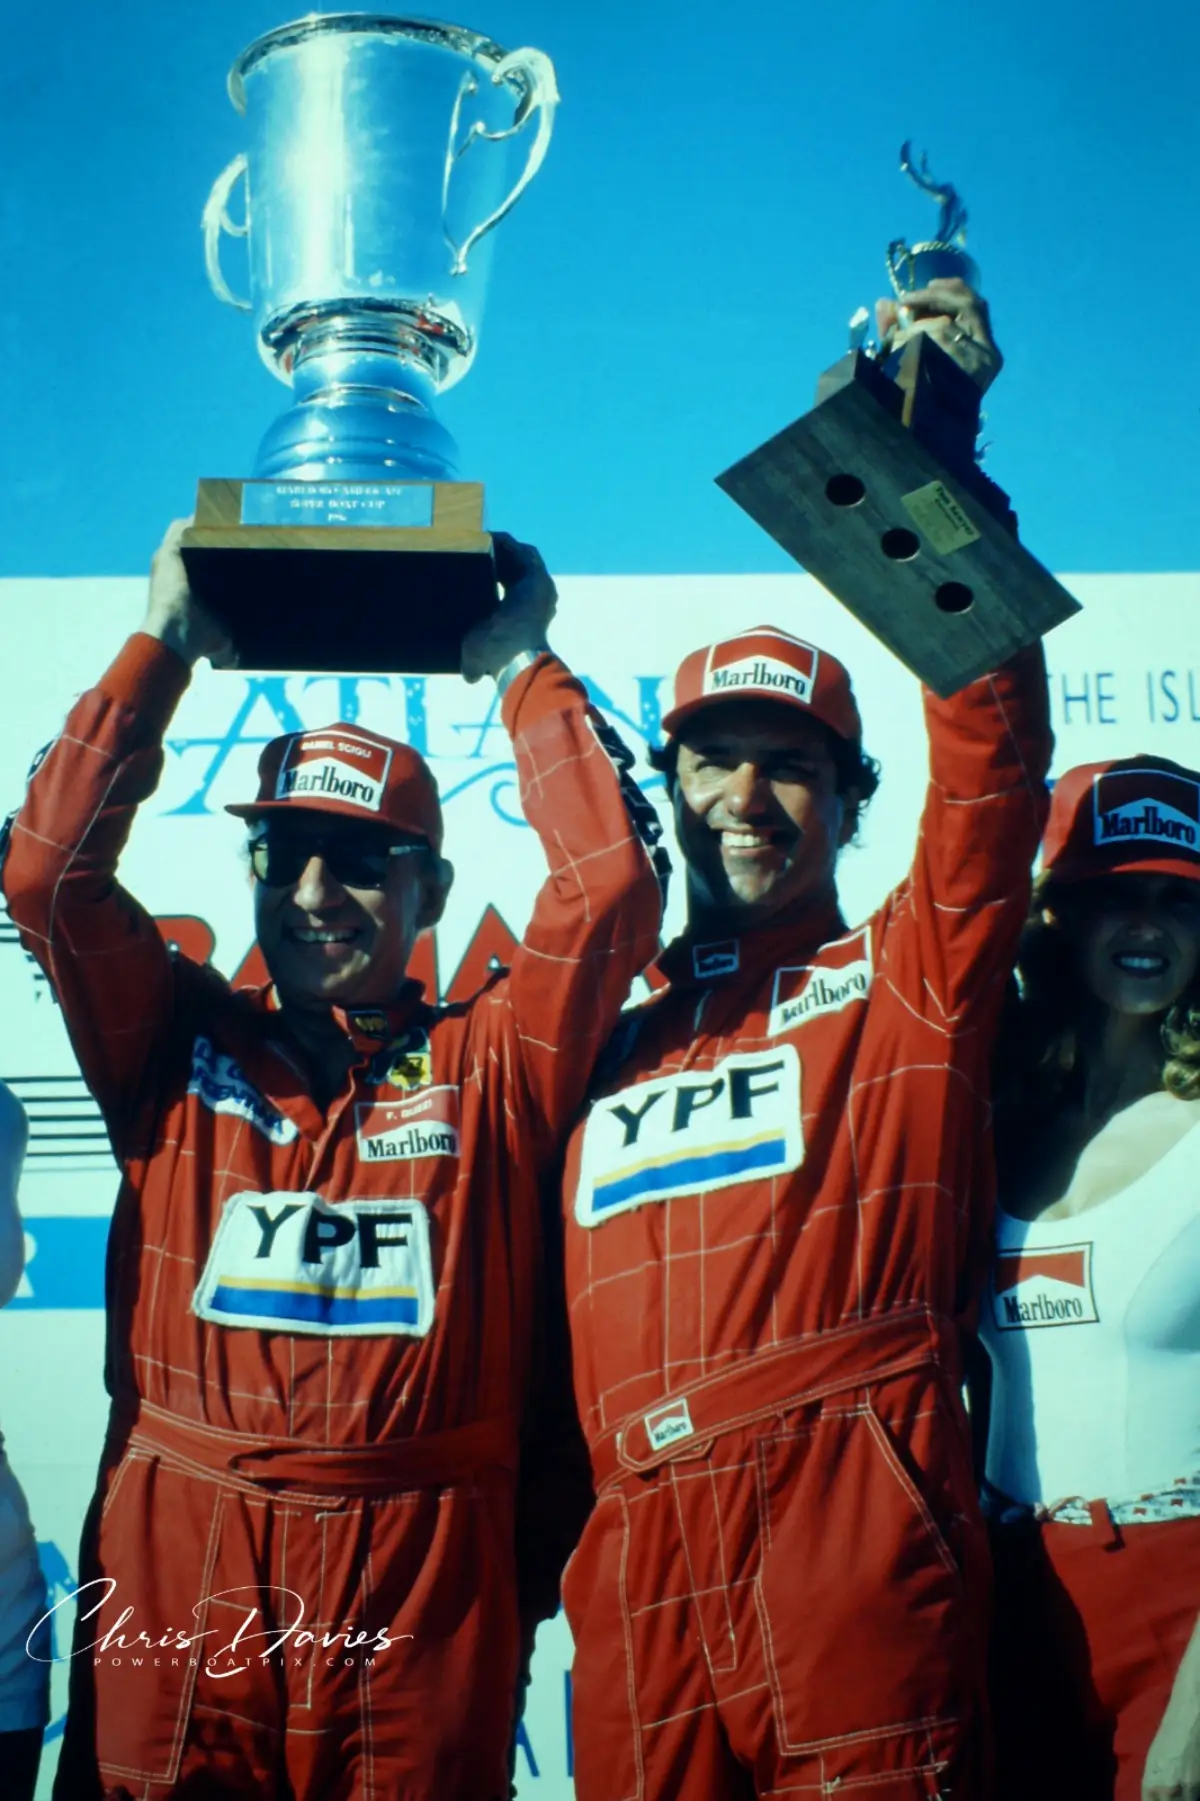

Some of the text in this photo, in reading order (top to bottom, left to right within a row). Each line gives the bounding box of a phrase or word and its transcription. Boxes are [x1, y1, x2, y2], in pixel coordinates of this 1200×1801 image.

[711, 663, 806, 695] Marlboro
[282, 766, 375, 803] Marlboro
[1102, 805, 1196, 845] Marlboro
[607, 1060, 785, 1147] YPF
[247, 1204, 413, 1268] YPF
[1003, 1293, 1083, 1323] Marlboro
